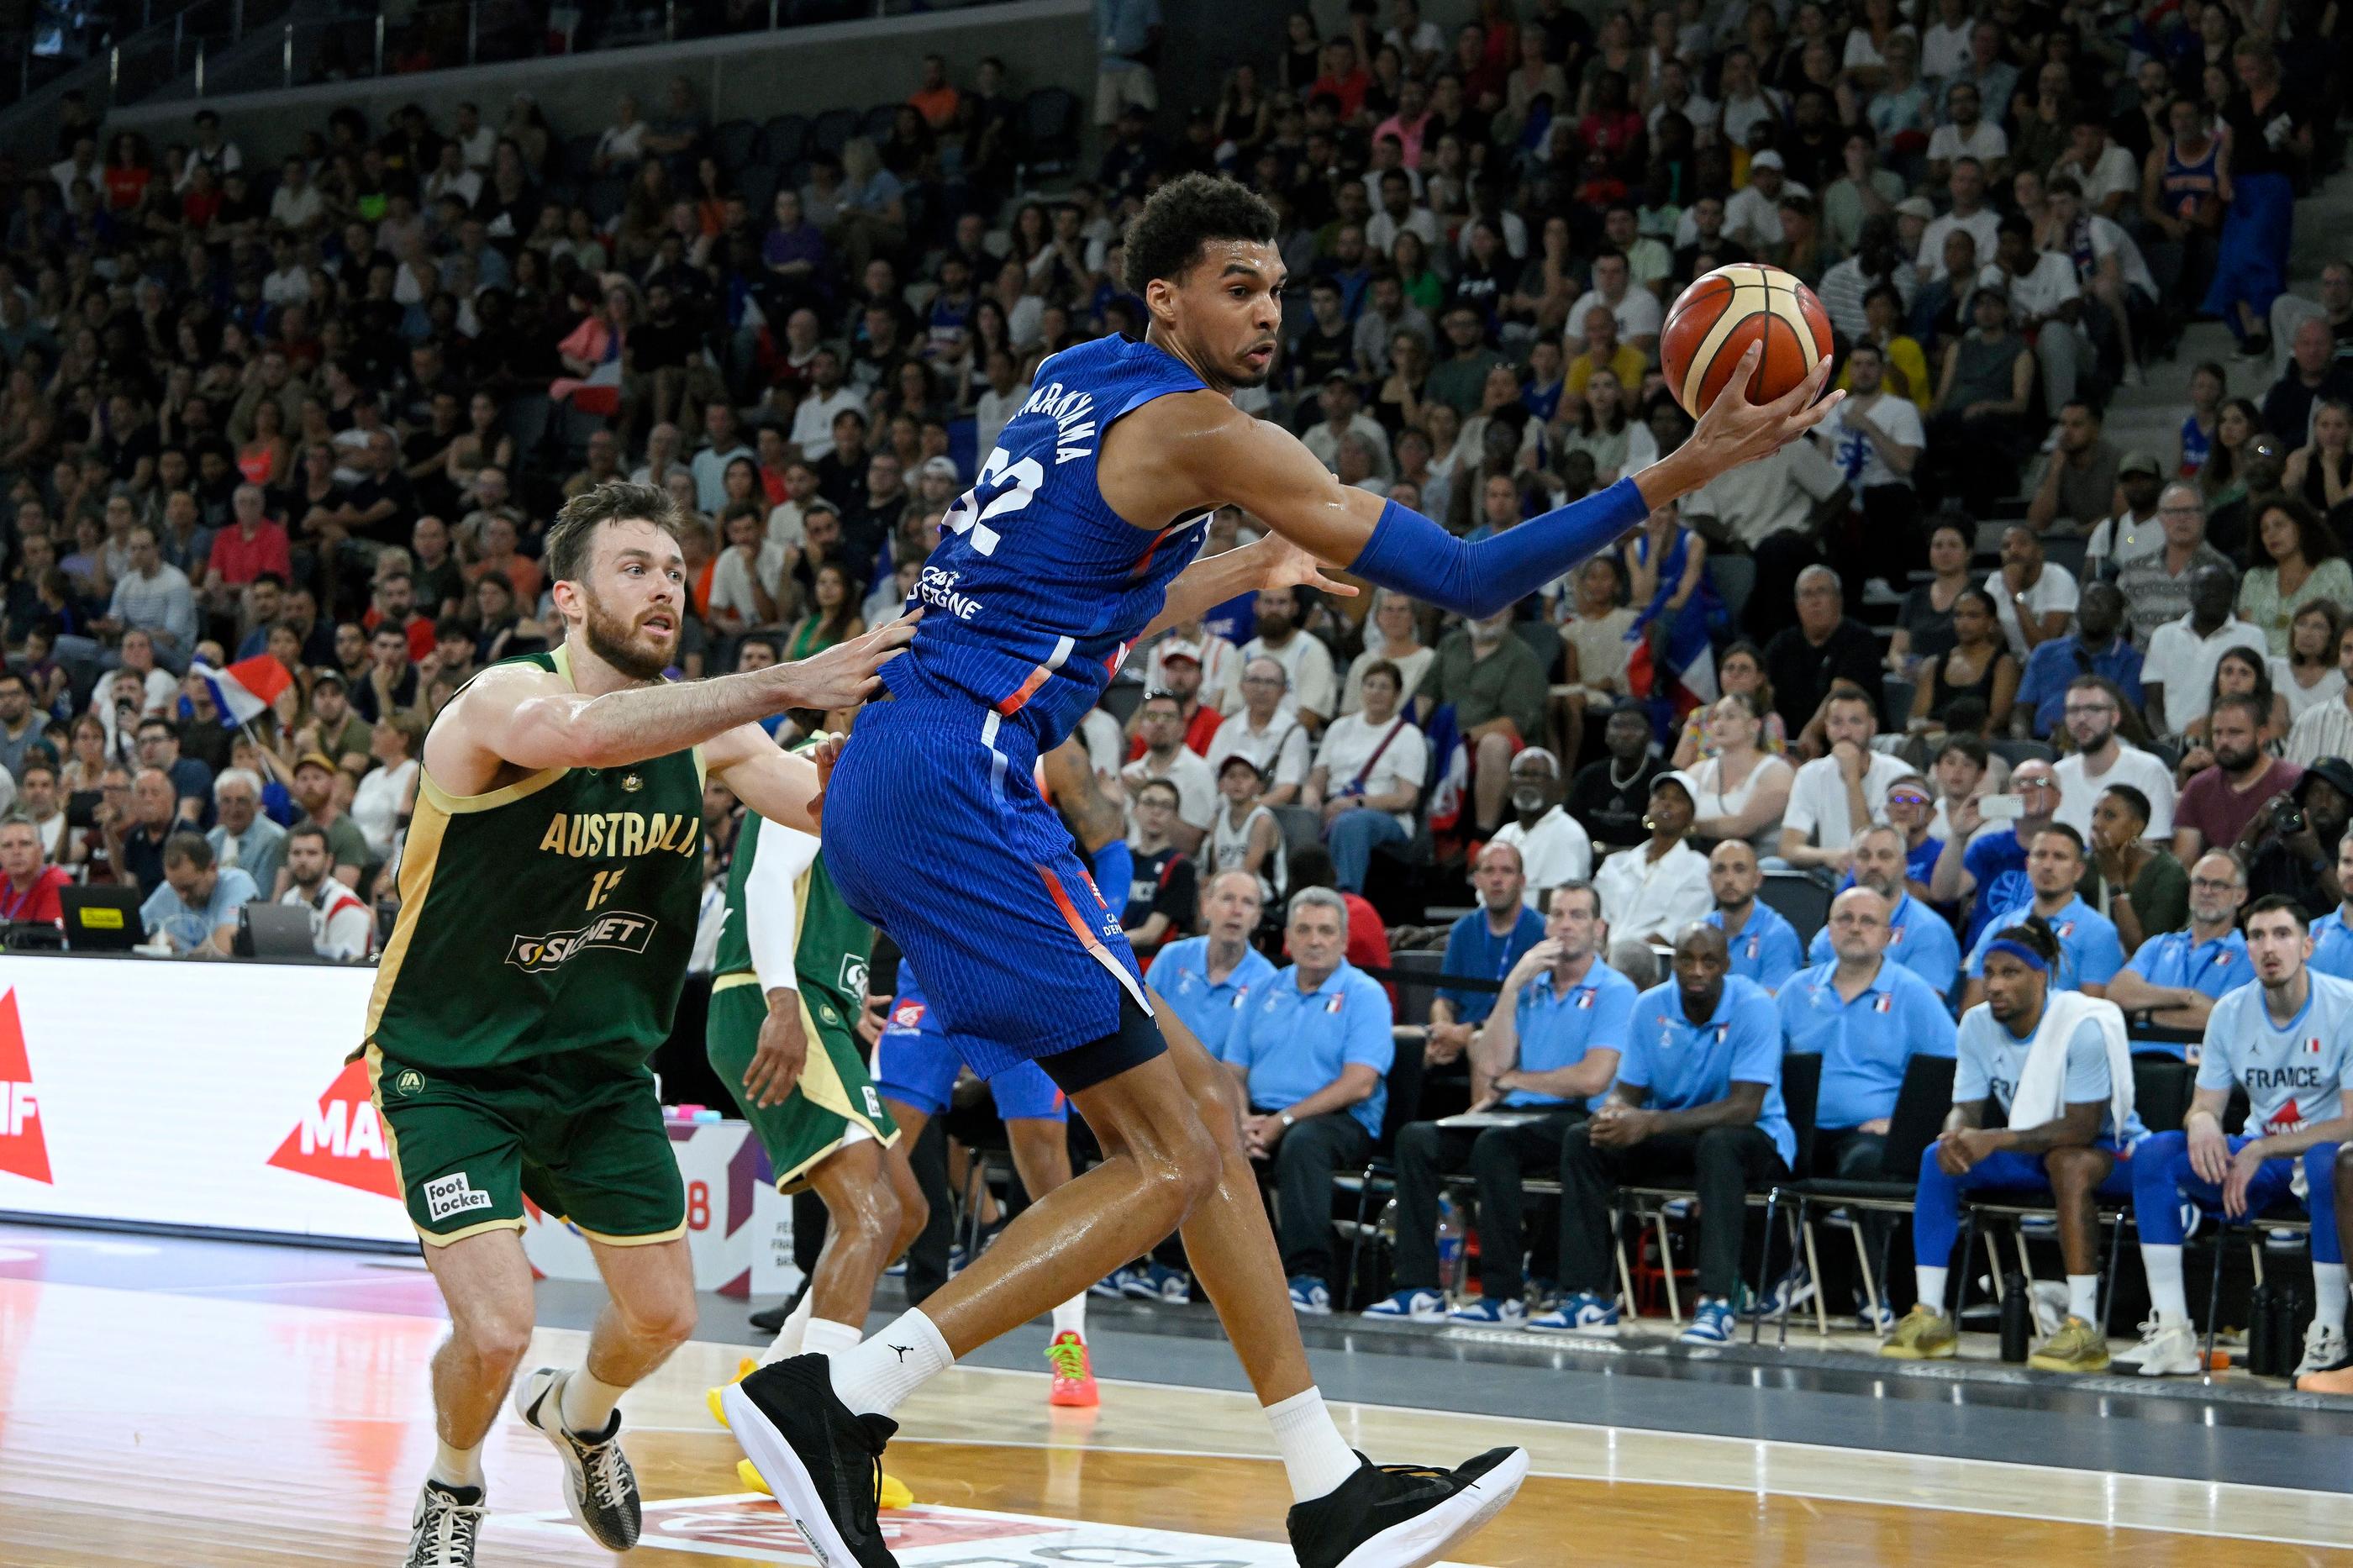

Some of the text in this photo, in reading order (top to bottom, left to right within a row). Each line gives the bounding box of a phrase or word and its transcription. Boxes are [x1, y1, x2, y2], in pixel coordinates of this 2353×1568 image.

[539, 812, 699, 858] AUSTRALI
[2245, 1066, 2321, 1088] FRANCE
[429, 1178, 464, 1200] Foot
[433, 1193, 485, 1215] Locker
